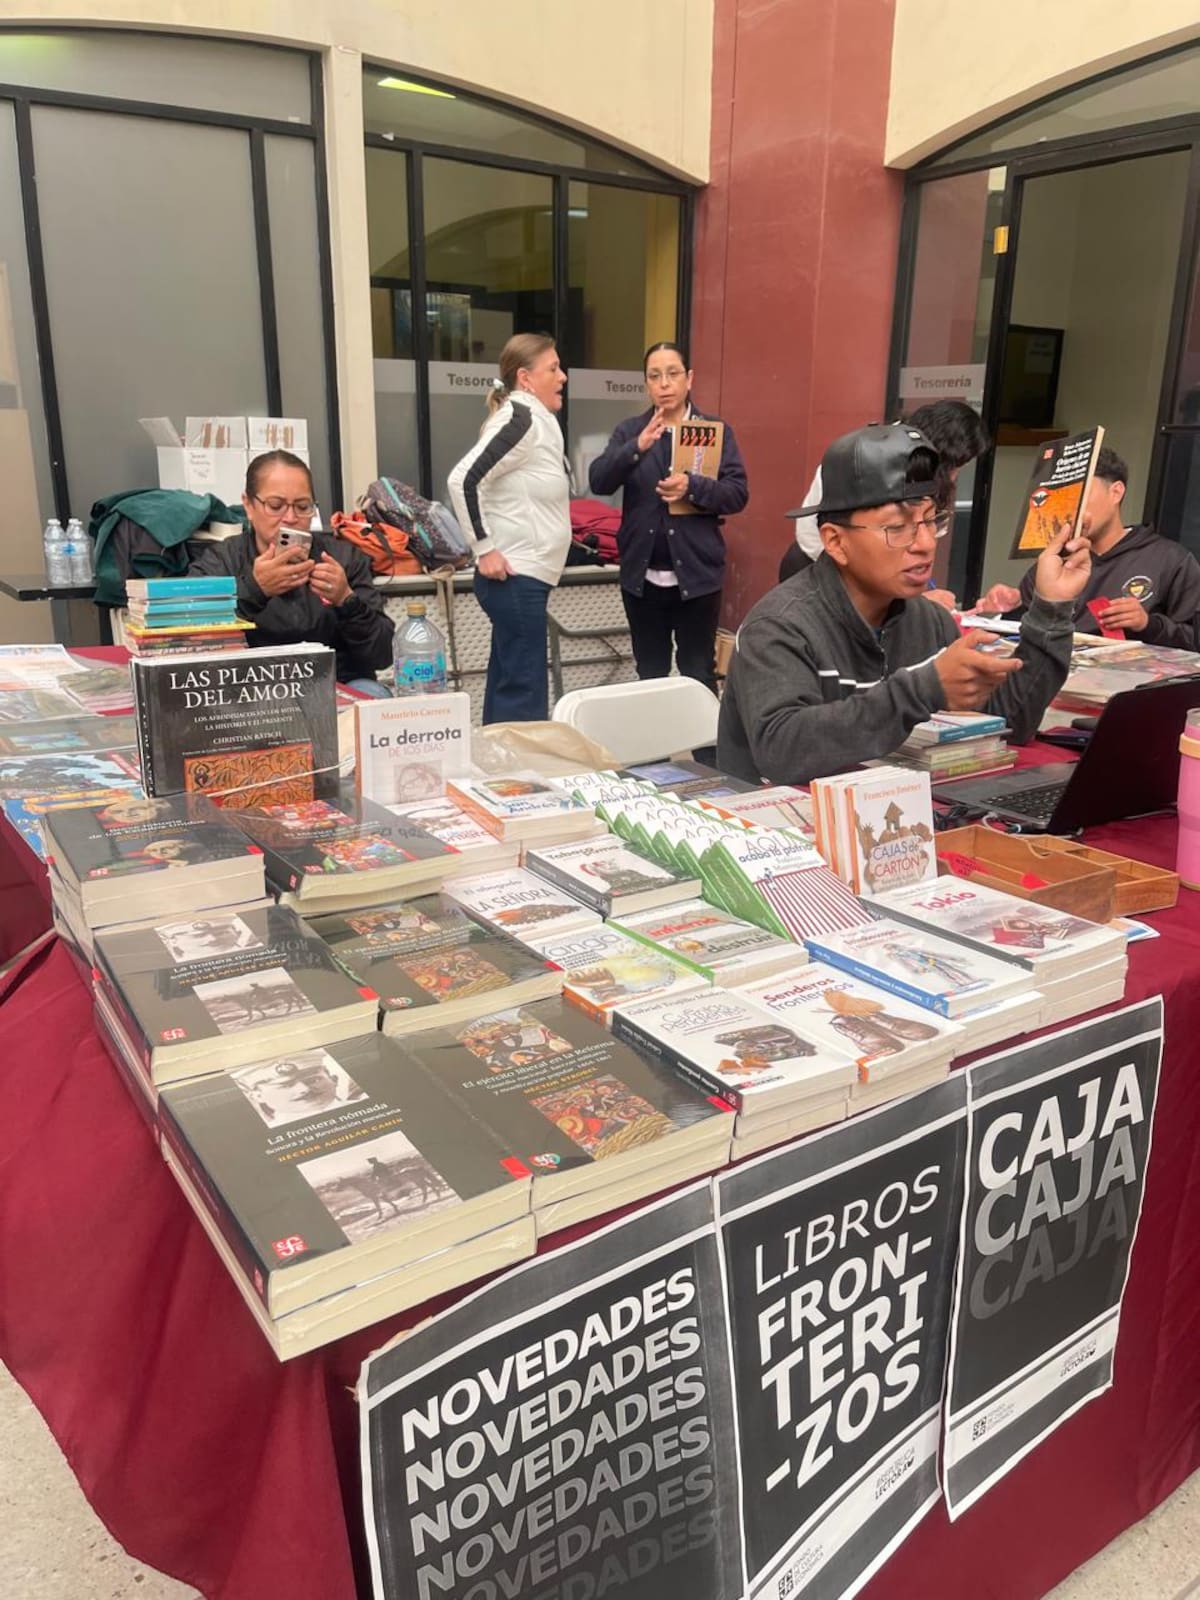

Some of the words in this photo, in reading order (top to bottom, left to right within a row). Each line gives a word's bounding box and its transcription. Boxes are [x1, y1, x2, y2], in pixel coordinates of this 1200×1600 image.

[447, 373, 495, 387] Tesore
[605, 380, 645, 393] Tesore
[170, 670, 211, 690] LAS
[218, 661, 315, 685] PLANTAS
[184, 688, 231, 709] DEL
[237, 682, 305, 704] AMOR
[370, 734, 390, 748] La
[397, 727, 462, 746] derrota
[738, 850, 770, 863] acaba
[783, 843, 813, 858] patria
[873, 840, 908, 861] CAJAS
[470, 898, 496, 914] LA
[493, 887, 557, 907] SEÑORA
[911, 891, 976, 911] Tokio
[190, 957, 232, 970] frontera
[763, 976, 836, 1003] Senderos
[766, 981, 855, 1012] fronterizos
[461, 1080, 475, 1090] El
[267, 1134, 285, 1146] La
[286, 1117, 338, 1140] frontera
[339, 1102, 389, 1121] nómada
[324, 1128, 369, 1148] AGUILAR
[978, 1063, 1144, 1190] CAJA
[265, 1141, 298, 1155] Sonora
[974, 1125, 1137, 1256] CAJA
[755, 1165, 940, 1296] LIBROS
[969, 1187, 1129, 1320] CAJA
[758, 1232, 932, 1366] FRON-
[401, 1267, 696, 1454] NOVEDADES
[761, 1271, 928, 1431] TERI
[405, 1317, 701, 1505] NOVEDADES
[766, 1339, 920, 1492] -ZOS
[409, 1366, 707, 1557] NOVEDADES
[875, 1463, 908, 1500] LECTORA
[416, 1416, 711, 1600] NOVEDADES
[453, 1465, 716, 1600] VEDADES
[530, 1513, 718, 1600] DADES
